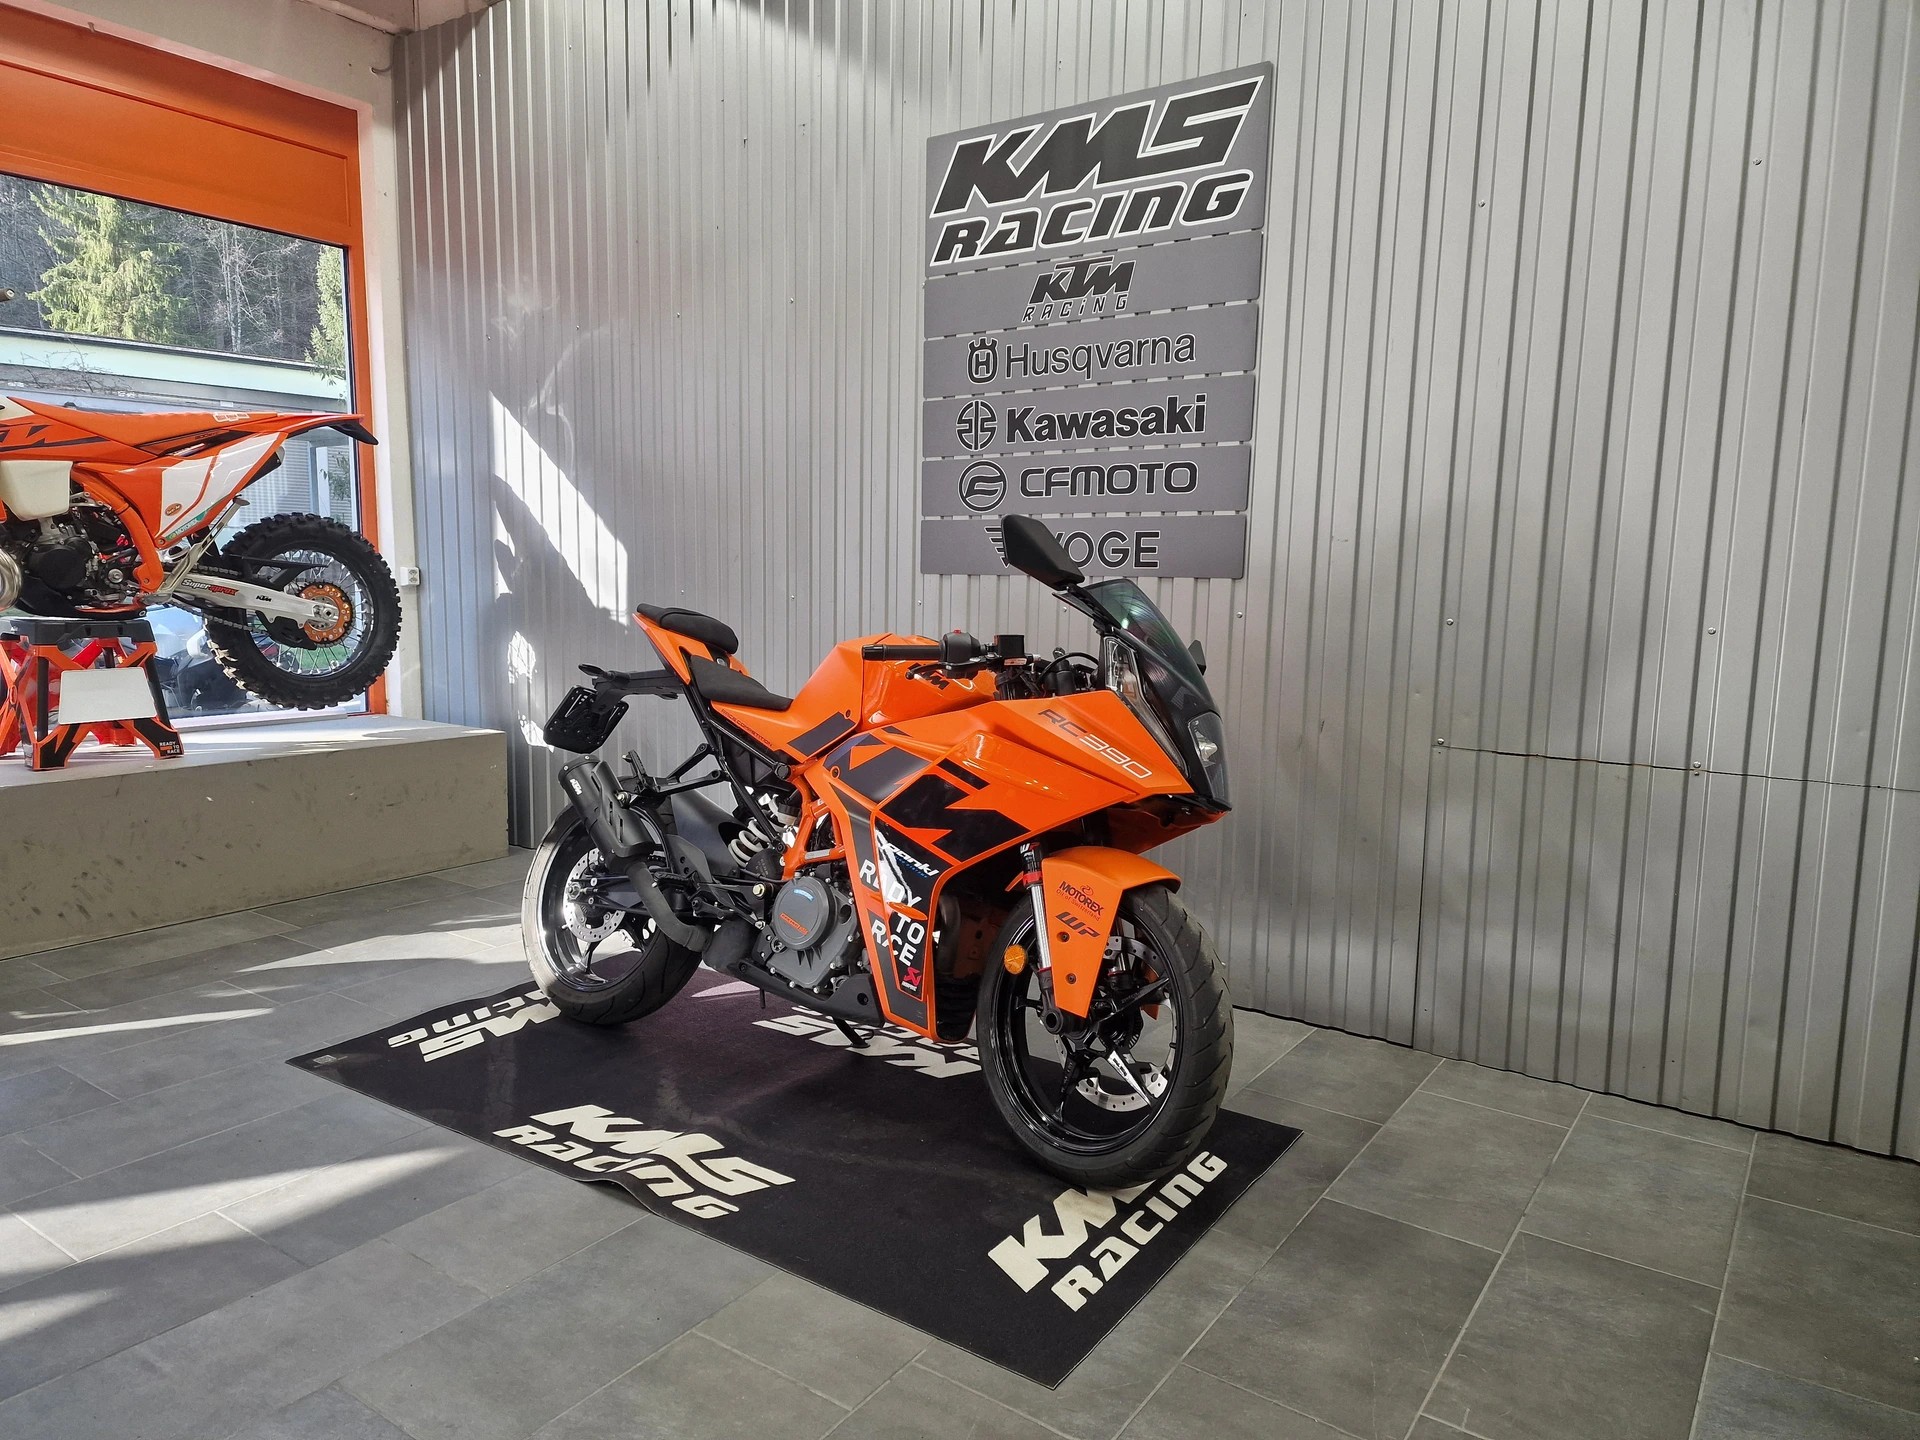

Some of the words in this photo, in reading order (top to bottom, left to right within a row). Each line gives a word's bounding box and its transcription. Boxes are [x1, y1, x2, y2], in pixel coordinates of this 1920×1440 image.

[929, 75, 1264, 218] KMS
[929, 169, 1254, 267] RACING
[1029, 255, 1136, 304] KTM
[1005, 333, 1196, 380] Husqvarna
[1006, 393, 1208, 443] Kawasaki
[1020, 461, 1198, 498] CFMOTO
[1055, 530, 1160, 569] OGE
[1059, 881, 1105, 916] MOTOREX
[896, 913, 925, 945] TO
[1056, 911, 1101, 938] WP
[419, 1000, 562, 1063] MS
[530, 1104, 796, 1196] KMS
[987, 1180, 1157, 1293] KM
[1051, 1151, 1228, 1312] RACING
